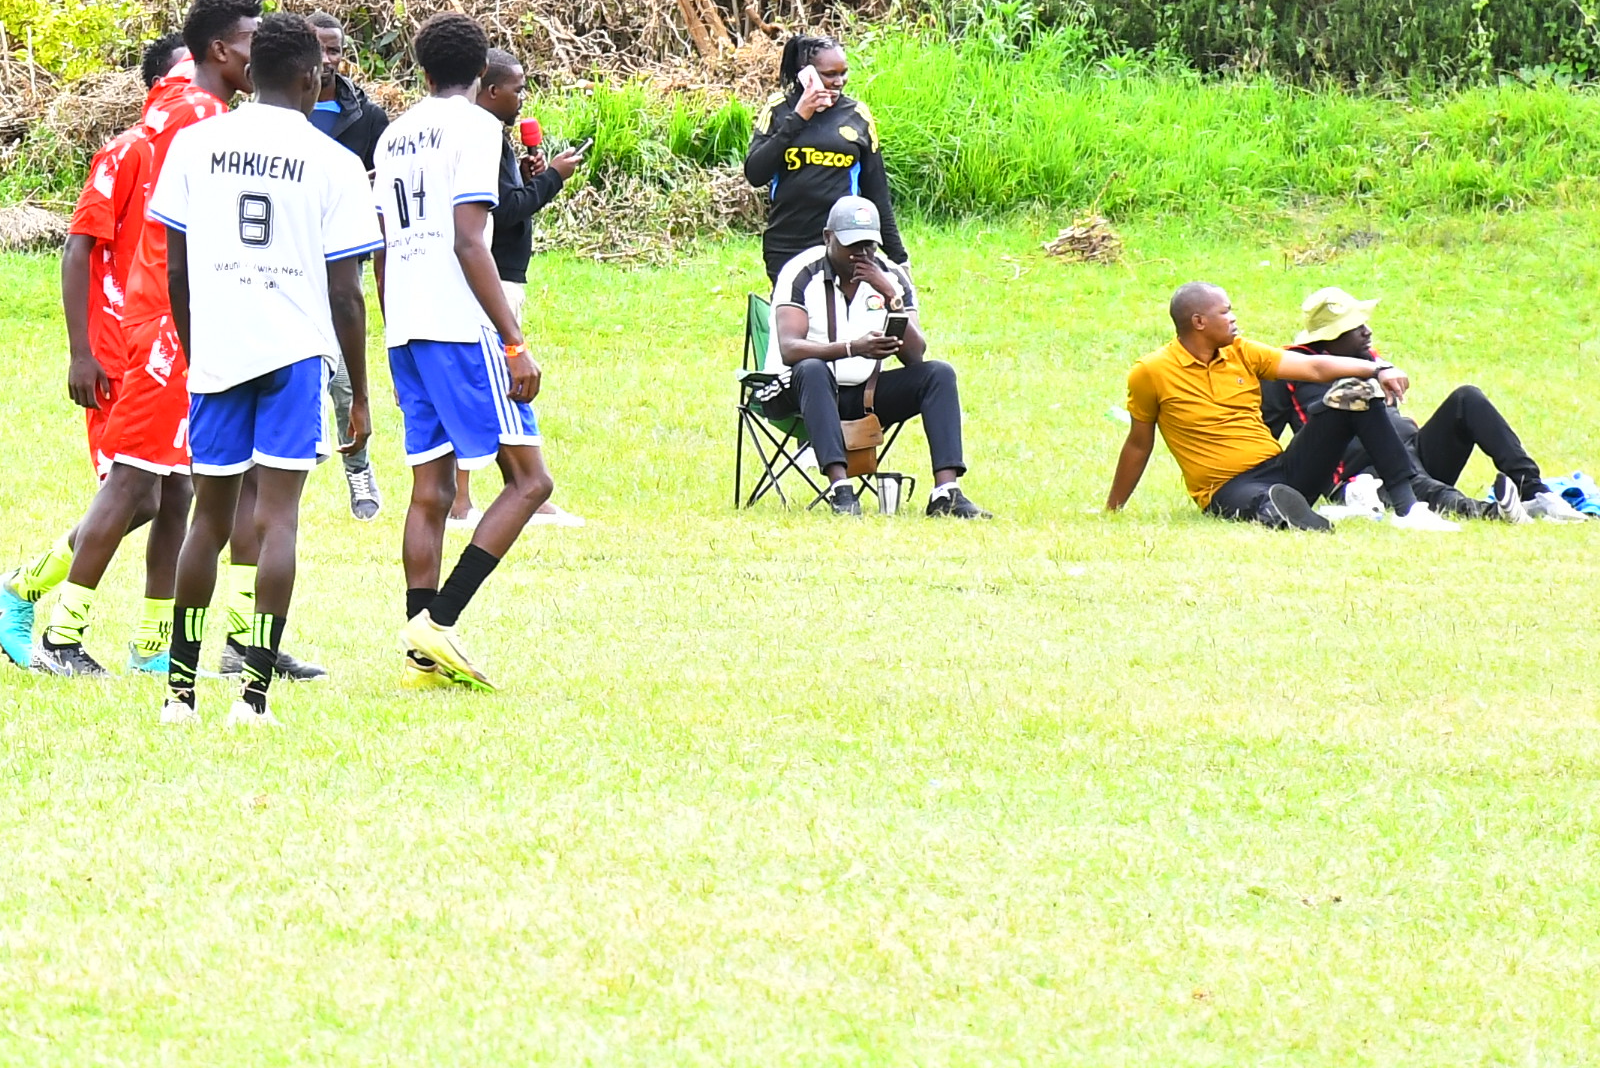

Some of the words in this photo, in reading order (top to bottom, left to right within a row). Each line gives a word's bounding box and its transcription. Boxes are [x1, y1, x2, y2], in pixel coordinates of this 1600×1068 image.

[211, 150, 305, 183] MAKUENI
[801, 147, 854, 168] Tezos
[237, 190, 275, 250] 8
